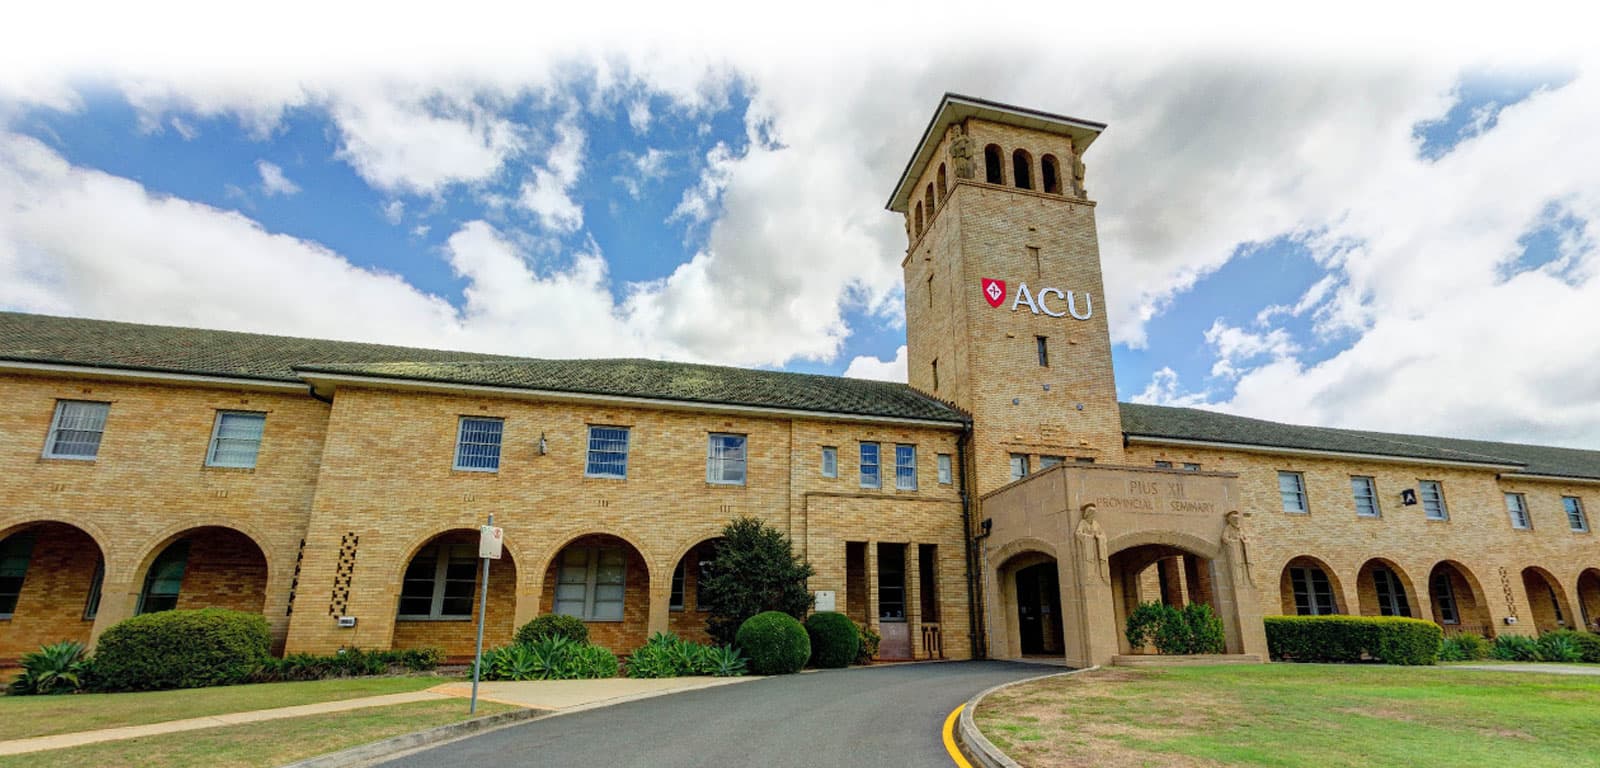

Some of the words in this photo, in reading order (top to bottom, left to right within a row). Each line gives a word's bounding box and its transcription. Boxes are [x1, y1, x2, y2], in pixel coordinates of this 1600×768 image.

[1011, 281, 1093, 321] ACU
[1129, 480, 1158, 495] PIUS
[1167, 482, 1185, 497] XII
[1096, 497, 1153, 510] PROVINCIAL
[1169, 500, 1215, 513] SEMINARY
